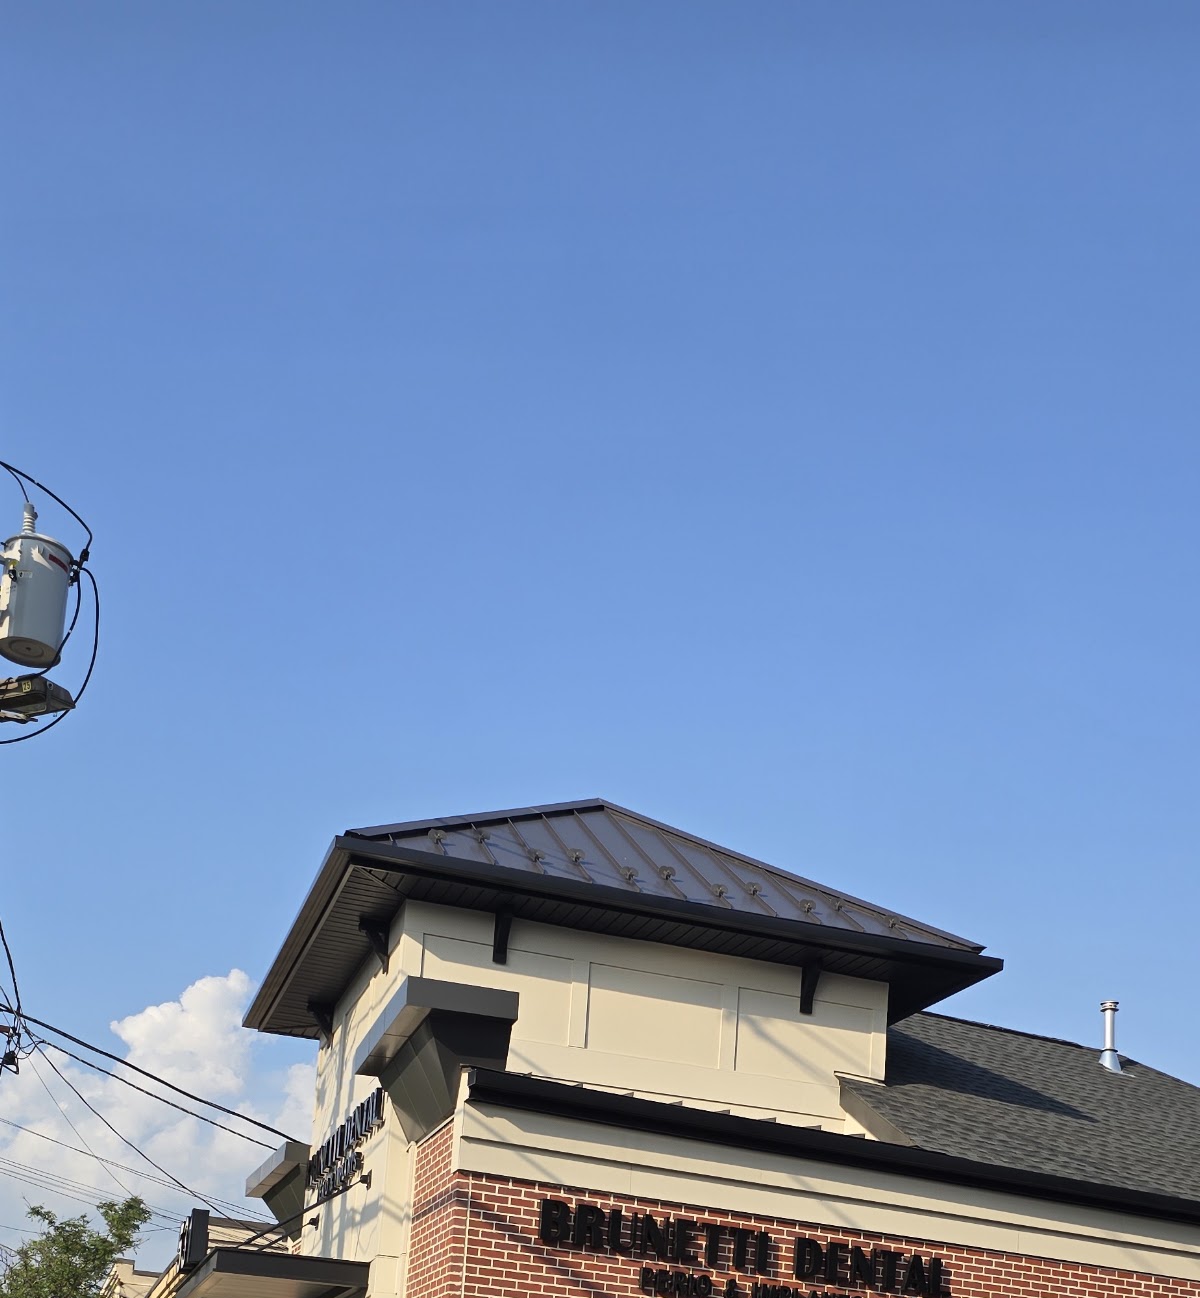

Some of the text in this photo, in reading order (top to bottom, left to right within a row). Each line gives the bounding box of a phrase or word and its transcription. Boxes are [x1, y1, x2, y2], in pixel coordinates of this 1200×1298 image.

[22, 681, 31, 691] 25
[540, 1198, 951, 1298] BRUNETTI DENTAL
[639, 1267, 712, 1298] PERIO
[724, 1278, 739, 1298] &
